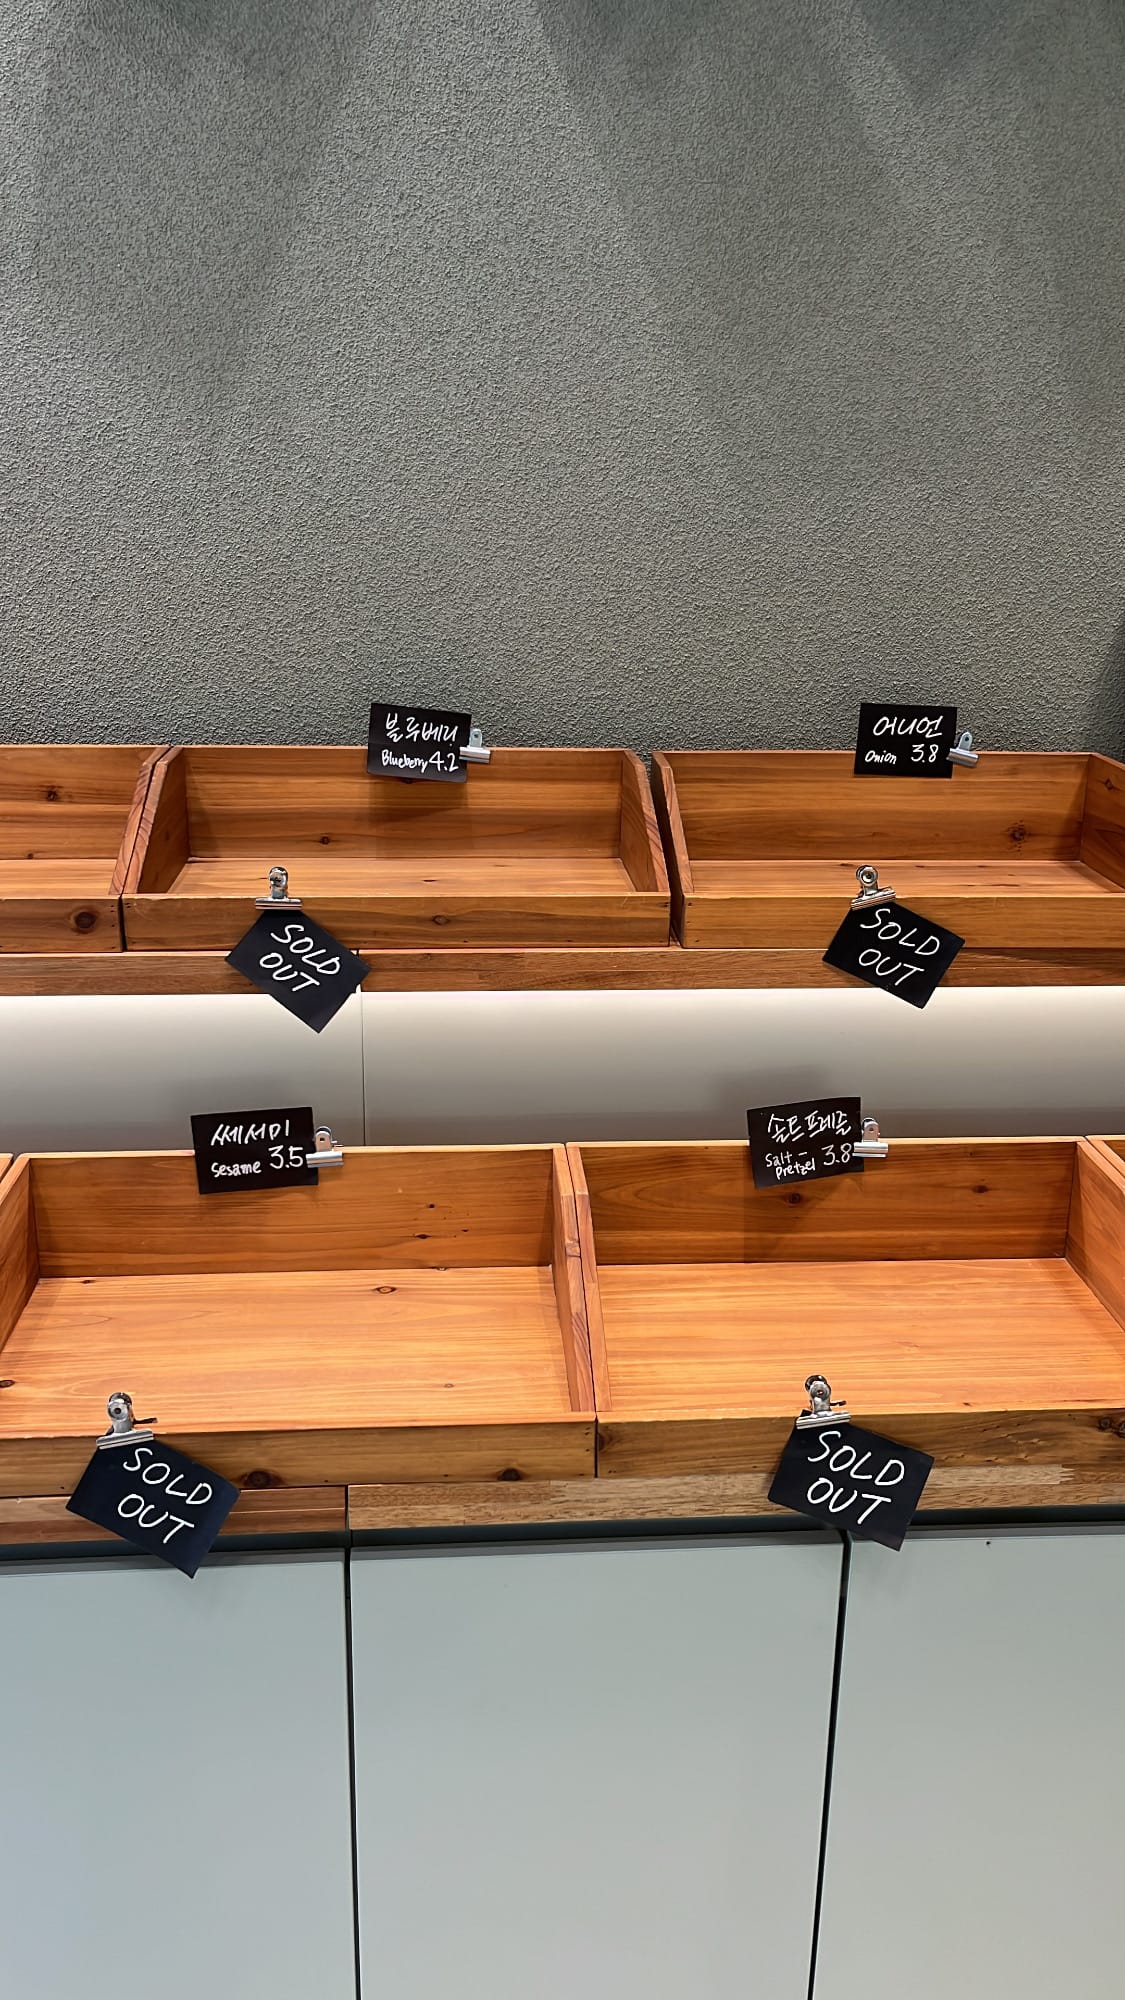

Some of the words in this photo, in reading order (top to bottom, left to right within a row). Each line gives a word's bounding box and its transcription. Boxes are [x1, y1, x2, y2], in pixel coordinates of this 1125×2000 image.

[386, 712, 458, 743] 블루베리
[872, 715, 944, 739] 어니언
[381, 749, 428, 774] Blueberry
[429, 751, 459, 773] 4.2
[911, 743, 939, 763] 3.8
[270, 924, 341, 975] SOLD
[860, 908, 940, 956] SOLD
[259, 952, 320, 992] OUT
[858, 948, 925, 986] OUT
[268, 1145, 304, 1169] 3.5
[821, 1142, 852, 1166] 3.8
[122, 1447, 213, 1505] SOLD
[807, 1430, 905, 1486] SOLD
[117, 1493, 195, 1544] OUT
[807, 1477, 892, 1525] OUT
